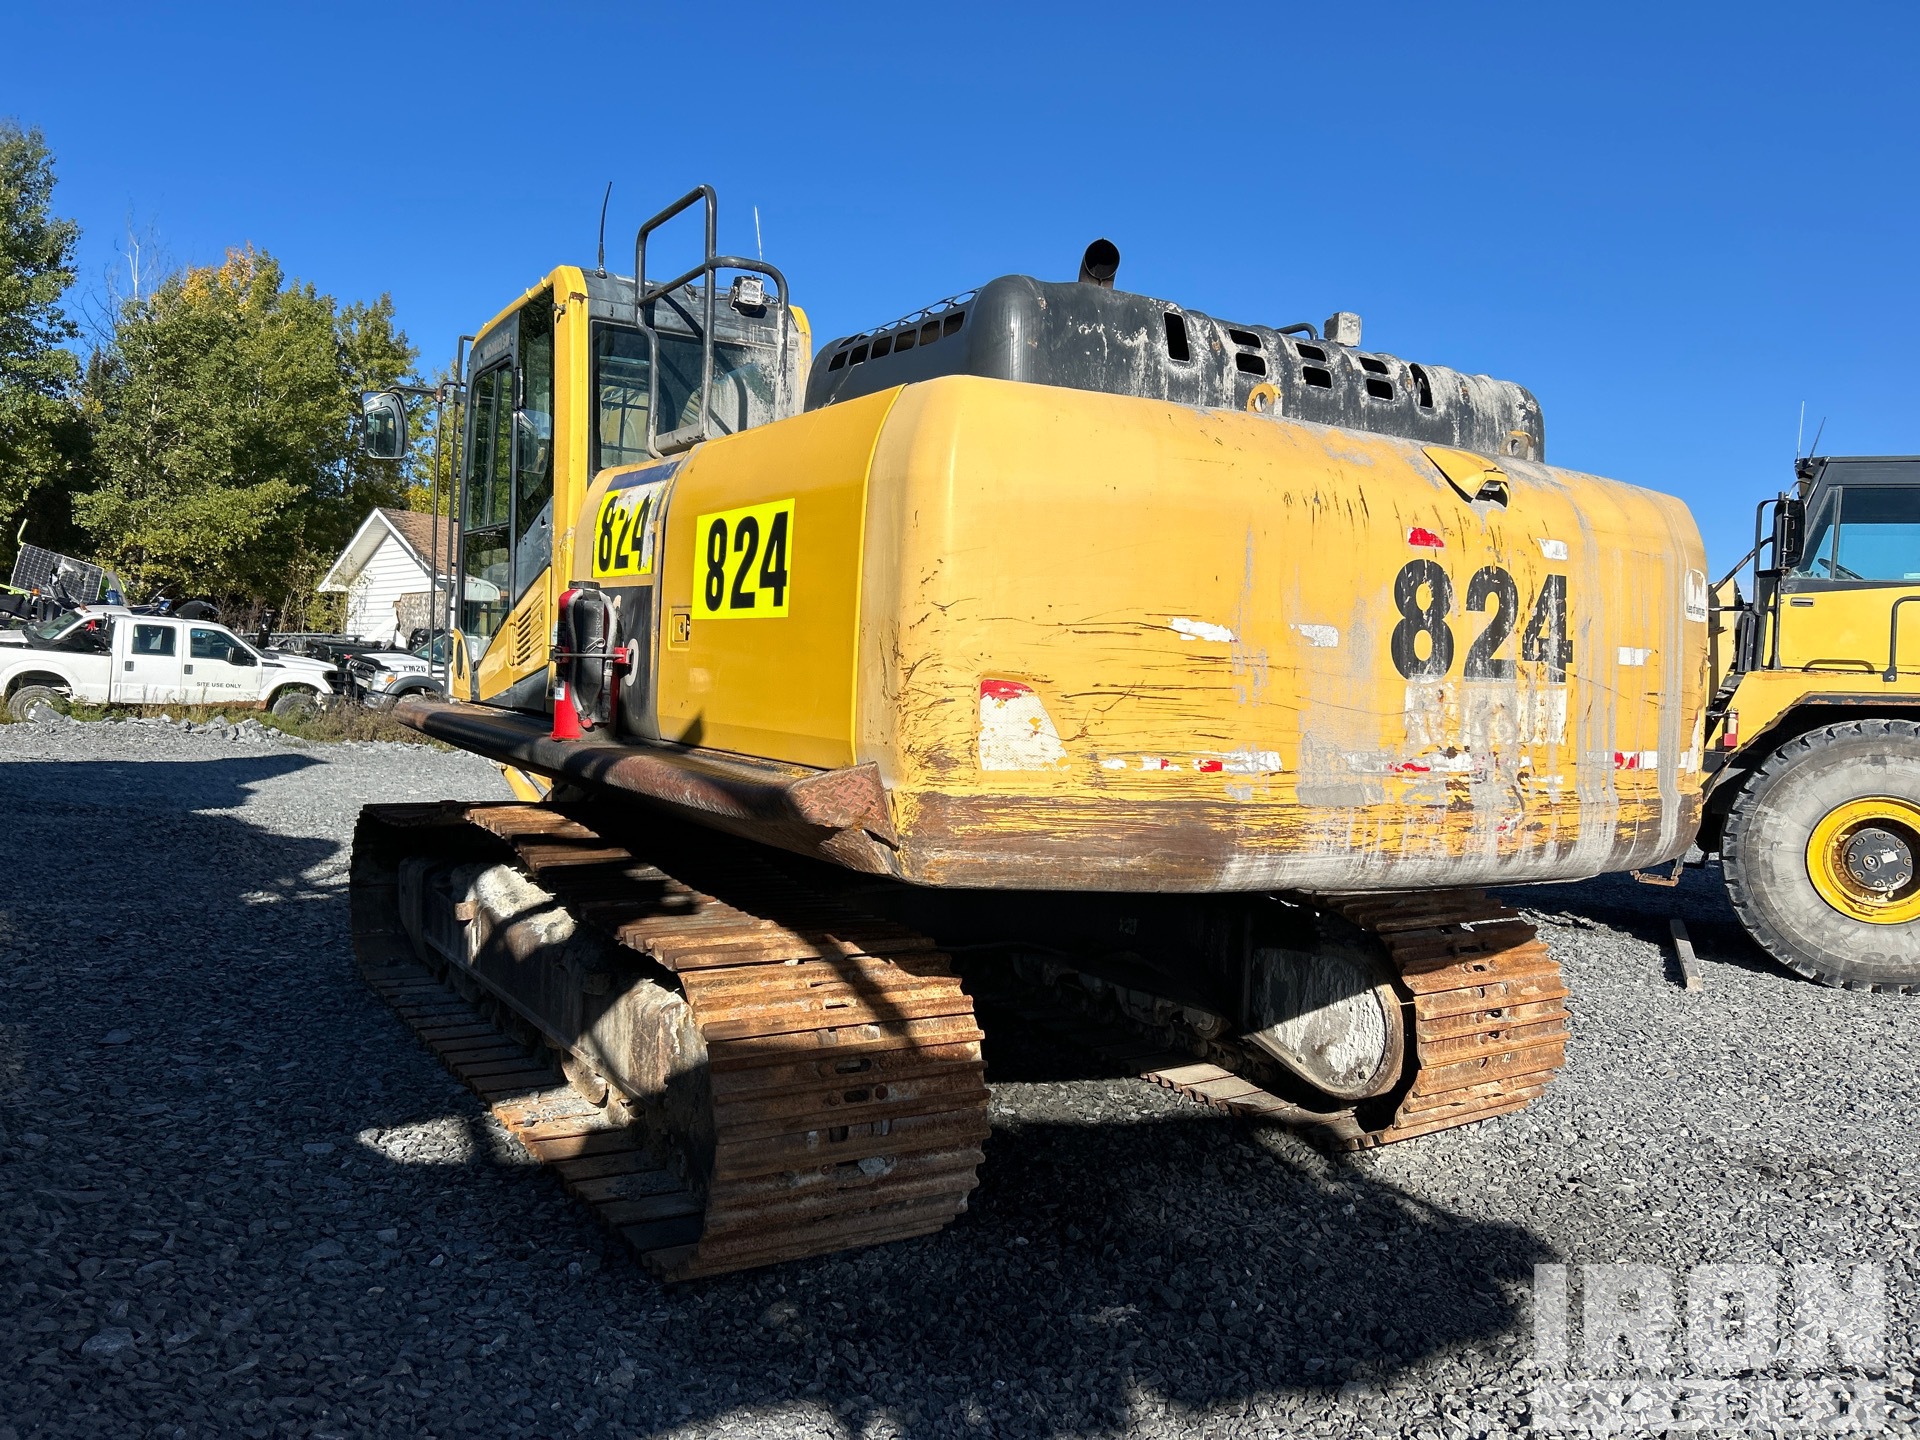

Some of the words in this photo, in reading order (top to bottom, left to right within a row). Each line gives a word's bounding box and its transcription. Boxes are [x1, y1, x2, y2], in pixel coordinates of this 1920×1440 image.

[599, 490, 654, 572] 824
[705, 511, 789, 611] 824
[1391, 559, 1573, 684] 824
